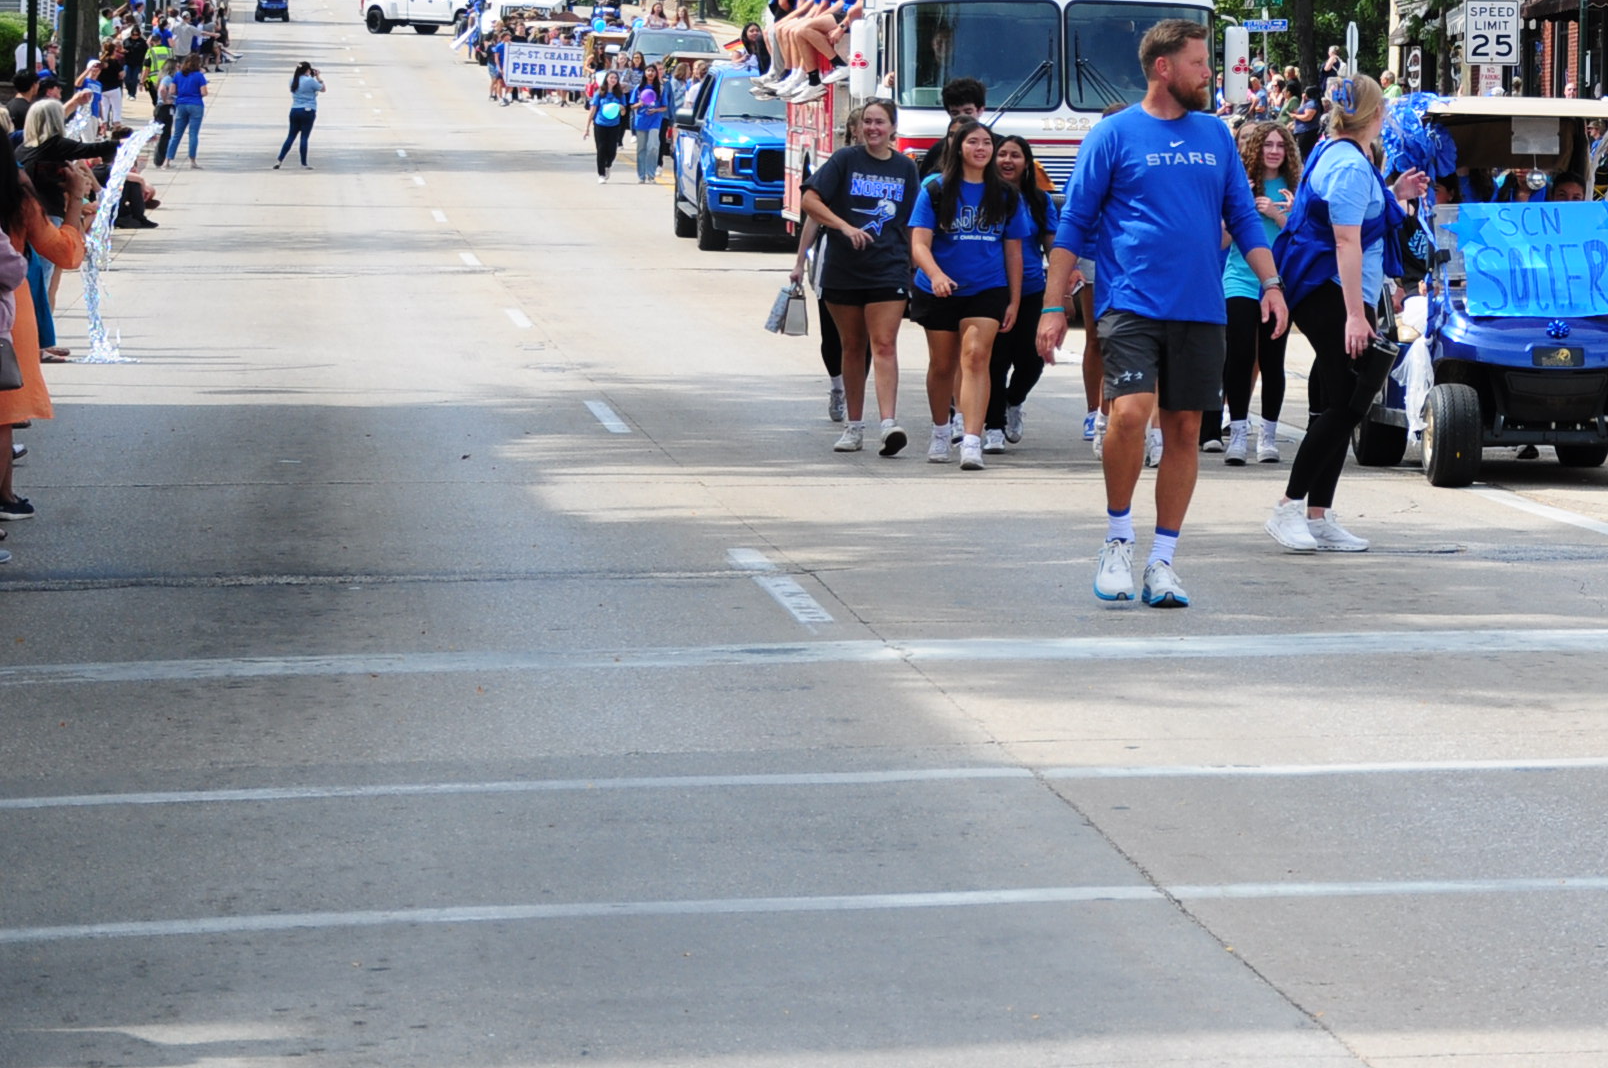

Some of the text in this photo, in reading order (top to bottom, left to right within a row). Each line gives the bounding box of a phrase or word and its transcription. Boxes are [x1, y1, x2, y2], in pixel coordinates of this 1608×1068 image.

[1470, 6, 1515, 17] SPEED
[1474, 20, 1510, 31] LIMIT
[1471, 34, 1513, 57] 25
[528, 51, 582, 62] ST. CHARLE
[512, 62, 547, 76] PEER
[1041, 117, 1091, 131] 1922
[1145, 151, 1217, 166] STARS
[850, 179, 904, 202] NORTH
[1498, 207, 1561, 237] SCN
